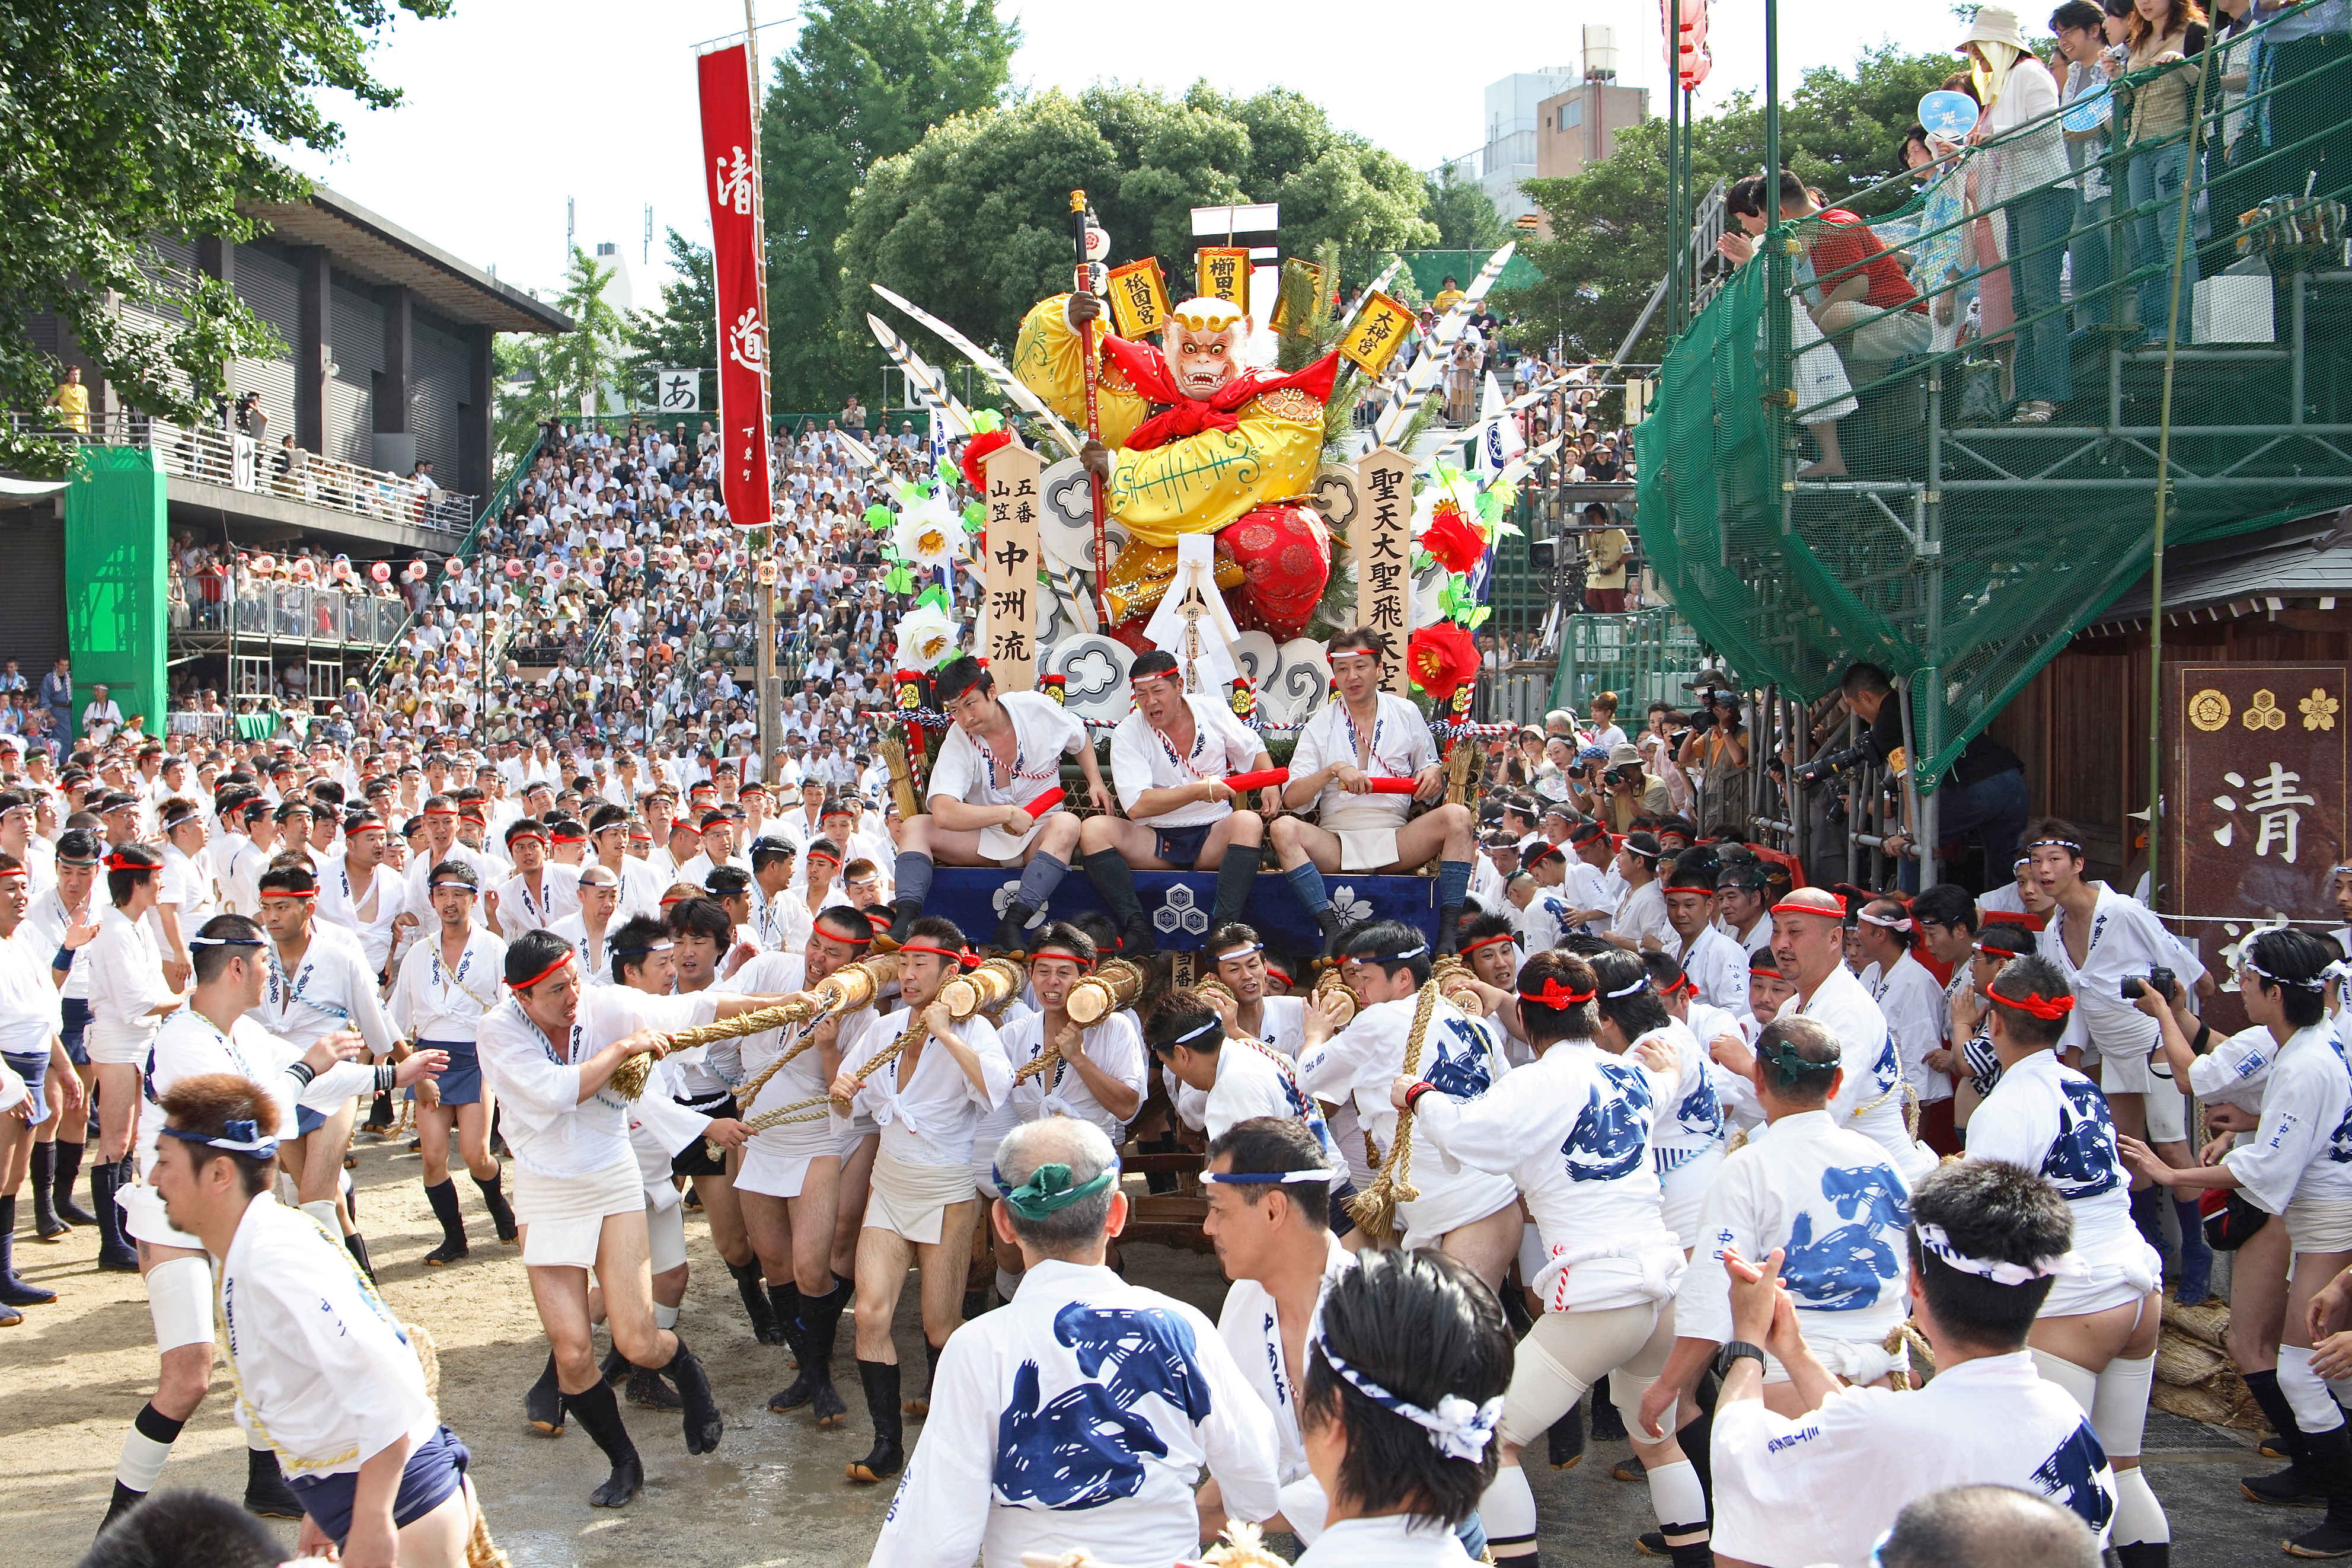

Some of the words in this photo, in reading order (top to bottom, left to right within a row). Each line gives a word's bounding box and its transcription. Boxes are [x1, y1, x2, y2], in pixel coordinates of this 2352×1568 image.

[717, 146, 761, 373] 清道
[1363, 310, 1394, 357] 大神宮
[663, 375, 696, 409] あ
[238, 441, 252, 487] け
[742, 426, 755, 481] 下東町
[990, 480, 1011, 523] 山笠
[1013, 478, 1036, 524] 五番
[991, 540, 1031, 662] 中洲流
[1367, 467, 1405, 692] 聖天大聖飛天空
[1175, 951, 1193, 988] 当番
[1733, 972, 1743, 992] 中五
[2270, 1123, 2289, 1149] 中五
